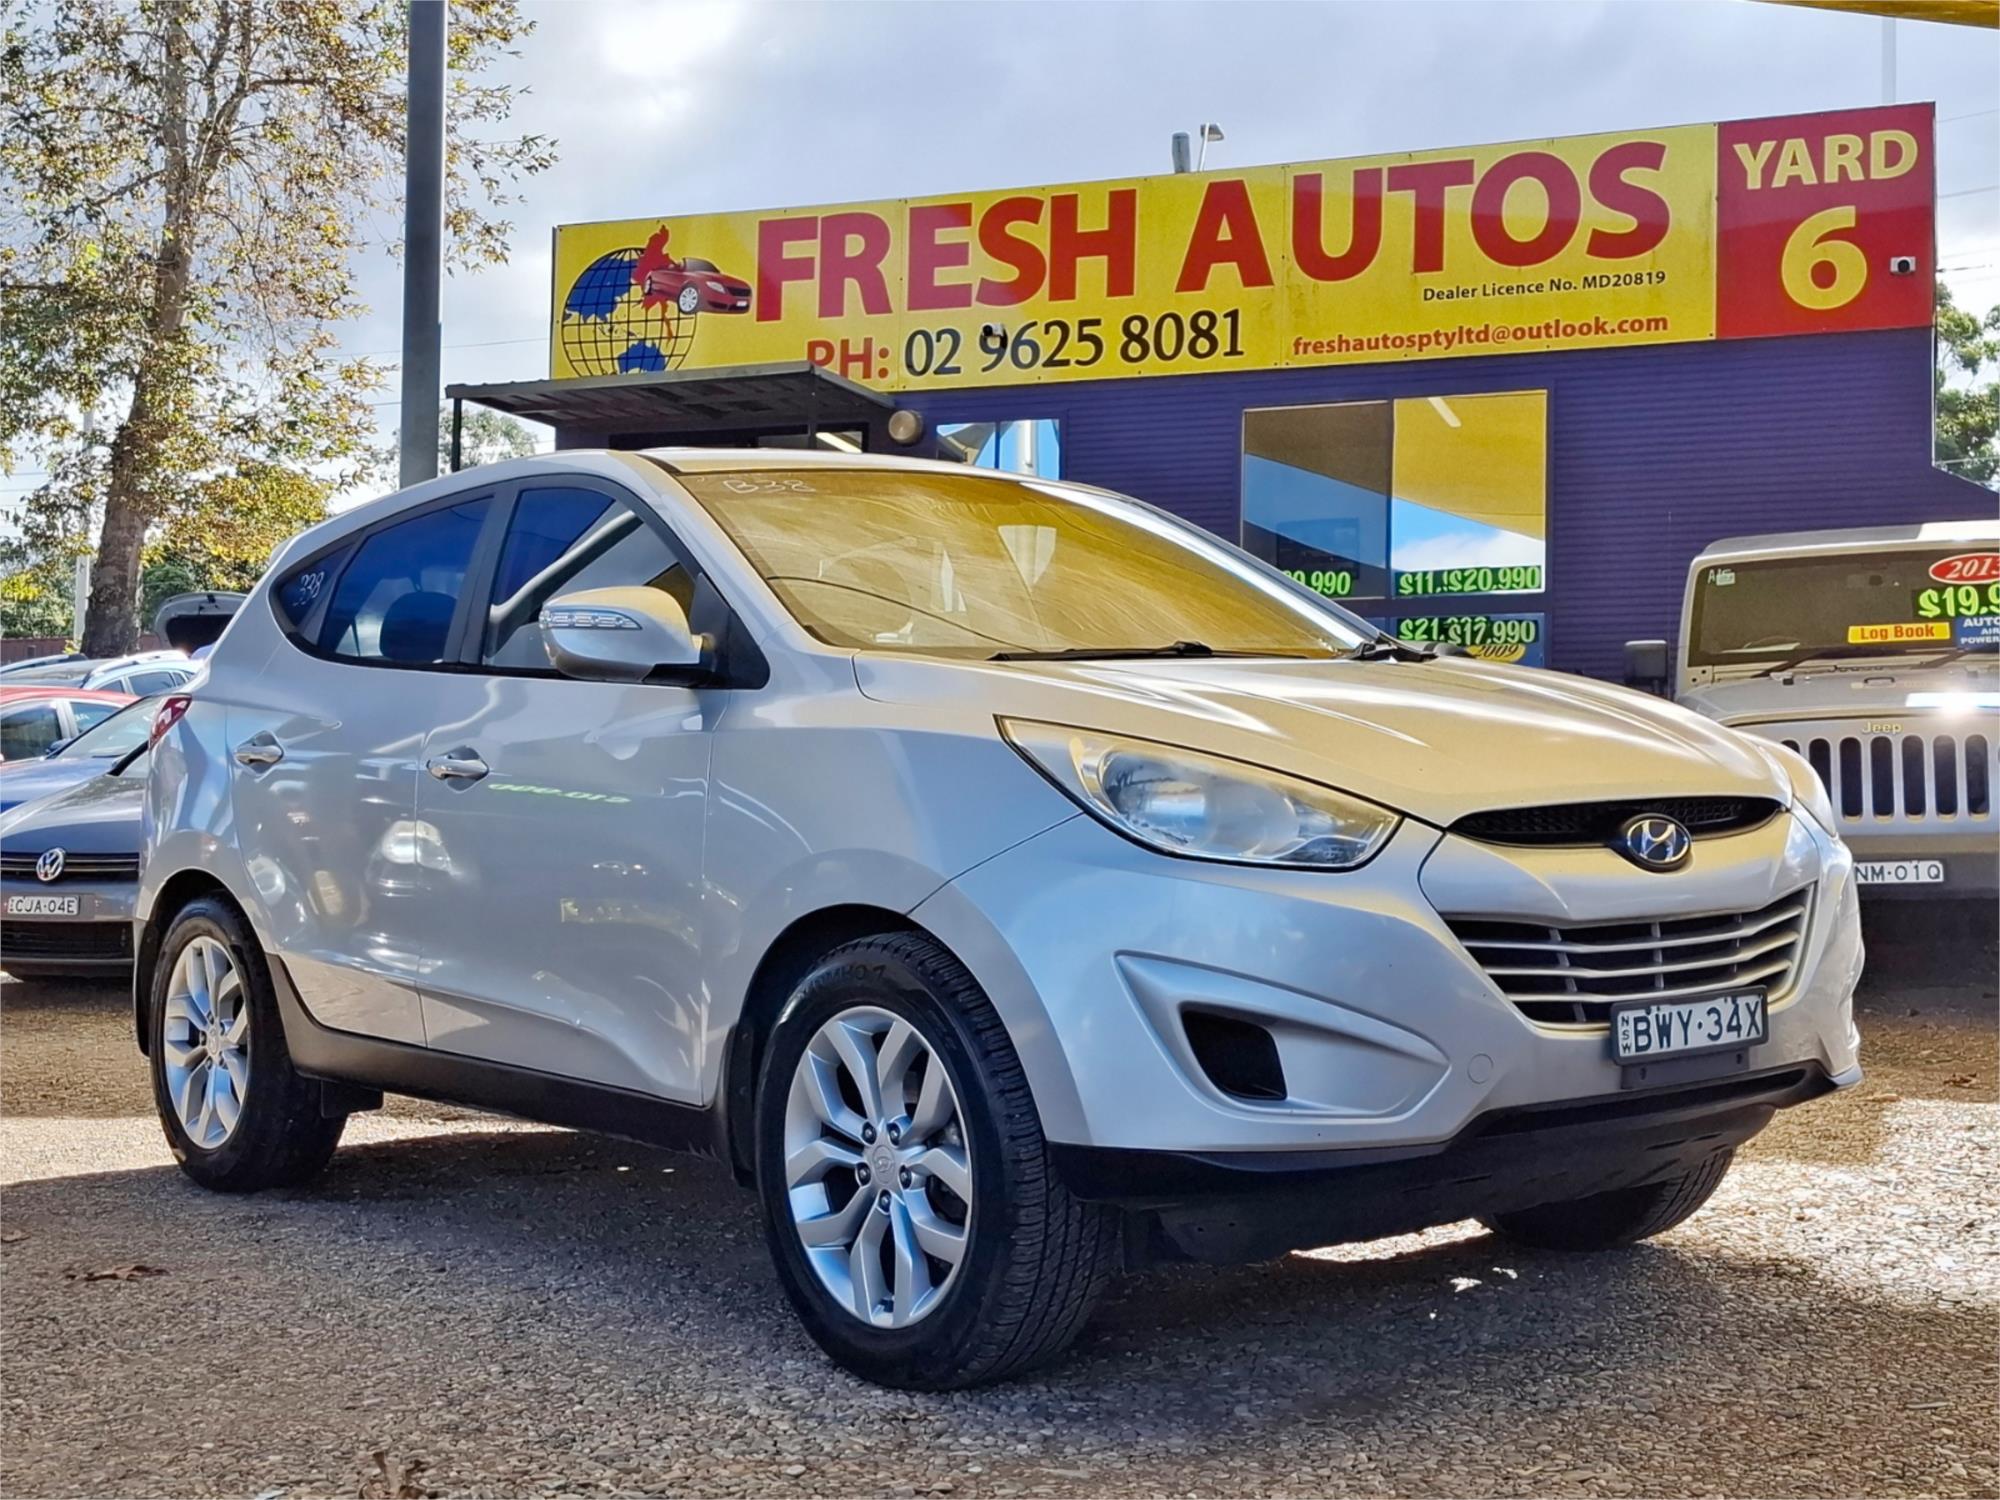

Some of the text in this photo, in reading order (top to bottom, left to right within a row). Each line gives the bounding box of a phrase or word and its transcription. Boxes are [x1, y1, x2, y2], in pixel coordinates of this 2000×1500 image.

[1732, 129, 1919, 190] YARD
[756, 140, 1670, 322] FRESH AUTOS
[1781, 205, 1868, 310] 6
[1423, 271, 1667, 302] Dealer Licence No. MD20819
[807, 308, 1245, 380] PH: 02 9625 8081
[1292, 316, 1669, 355] freshautosptyltd@outlook.com
[1447, 566, 1541, 592] $20.990
[1447, 620, 1536, 645] $17.990
[1860, 625, 1935, 641] Log Book
[1862, 721, 1902, 735] Jeep
